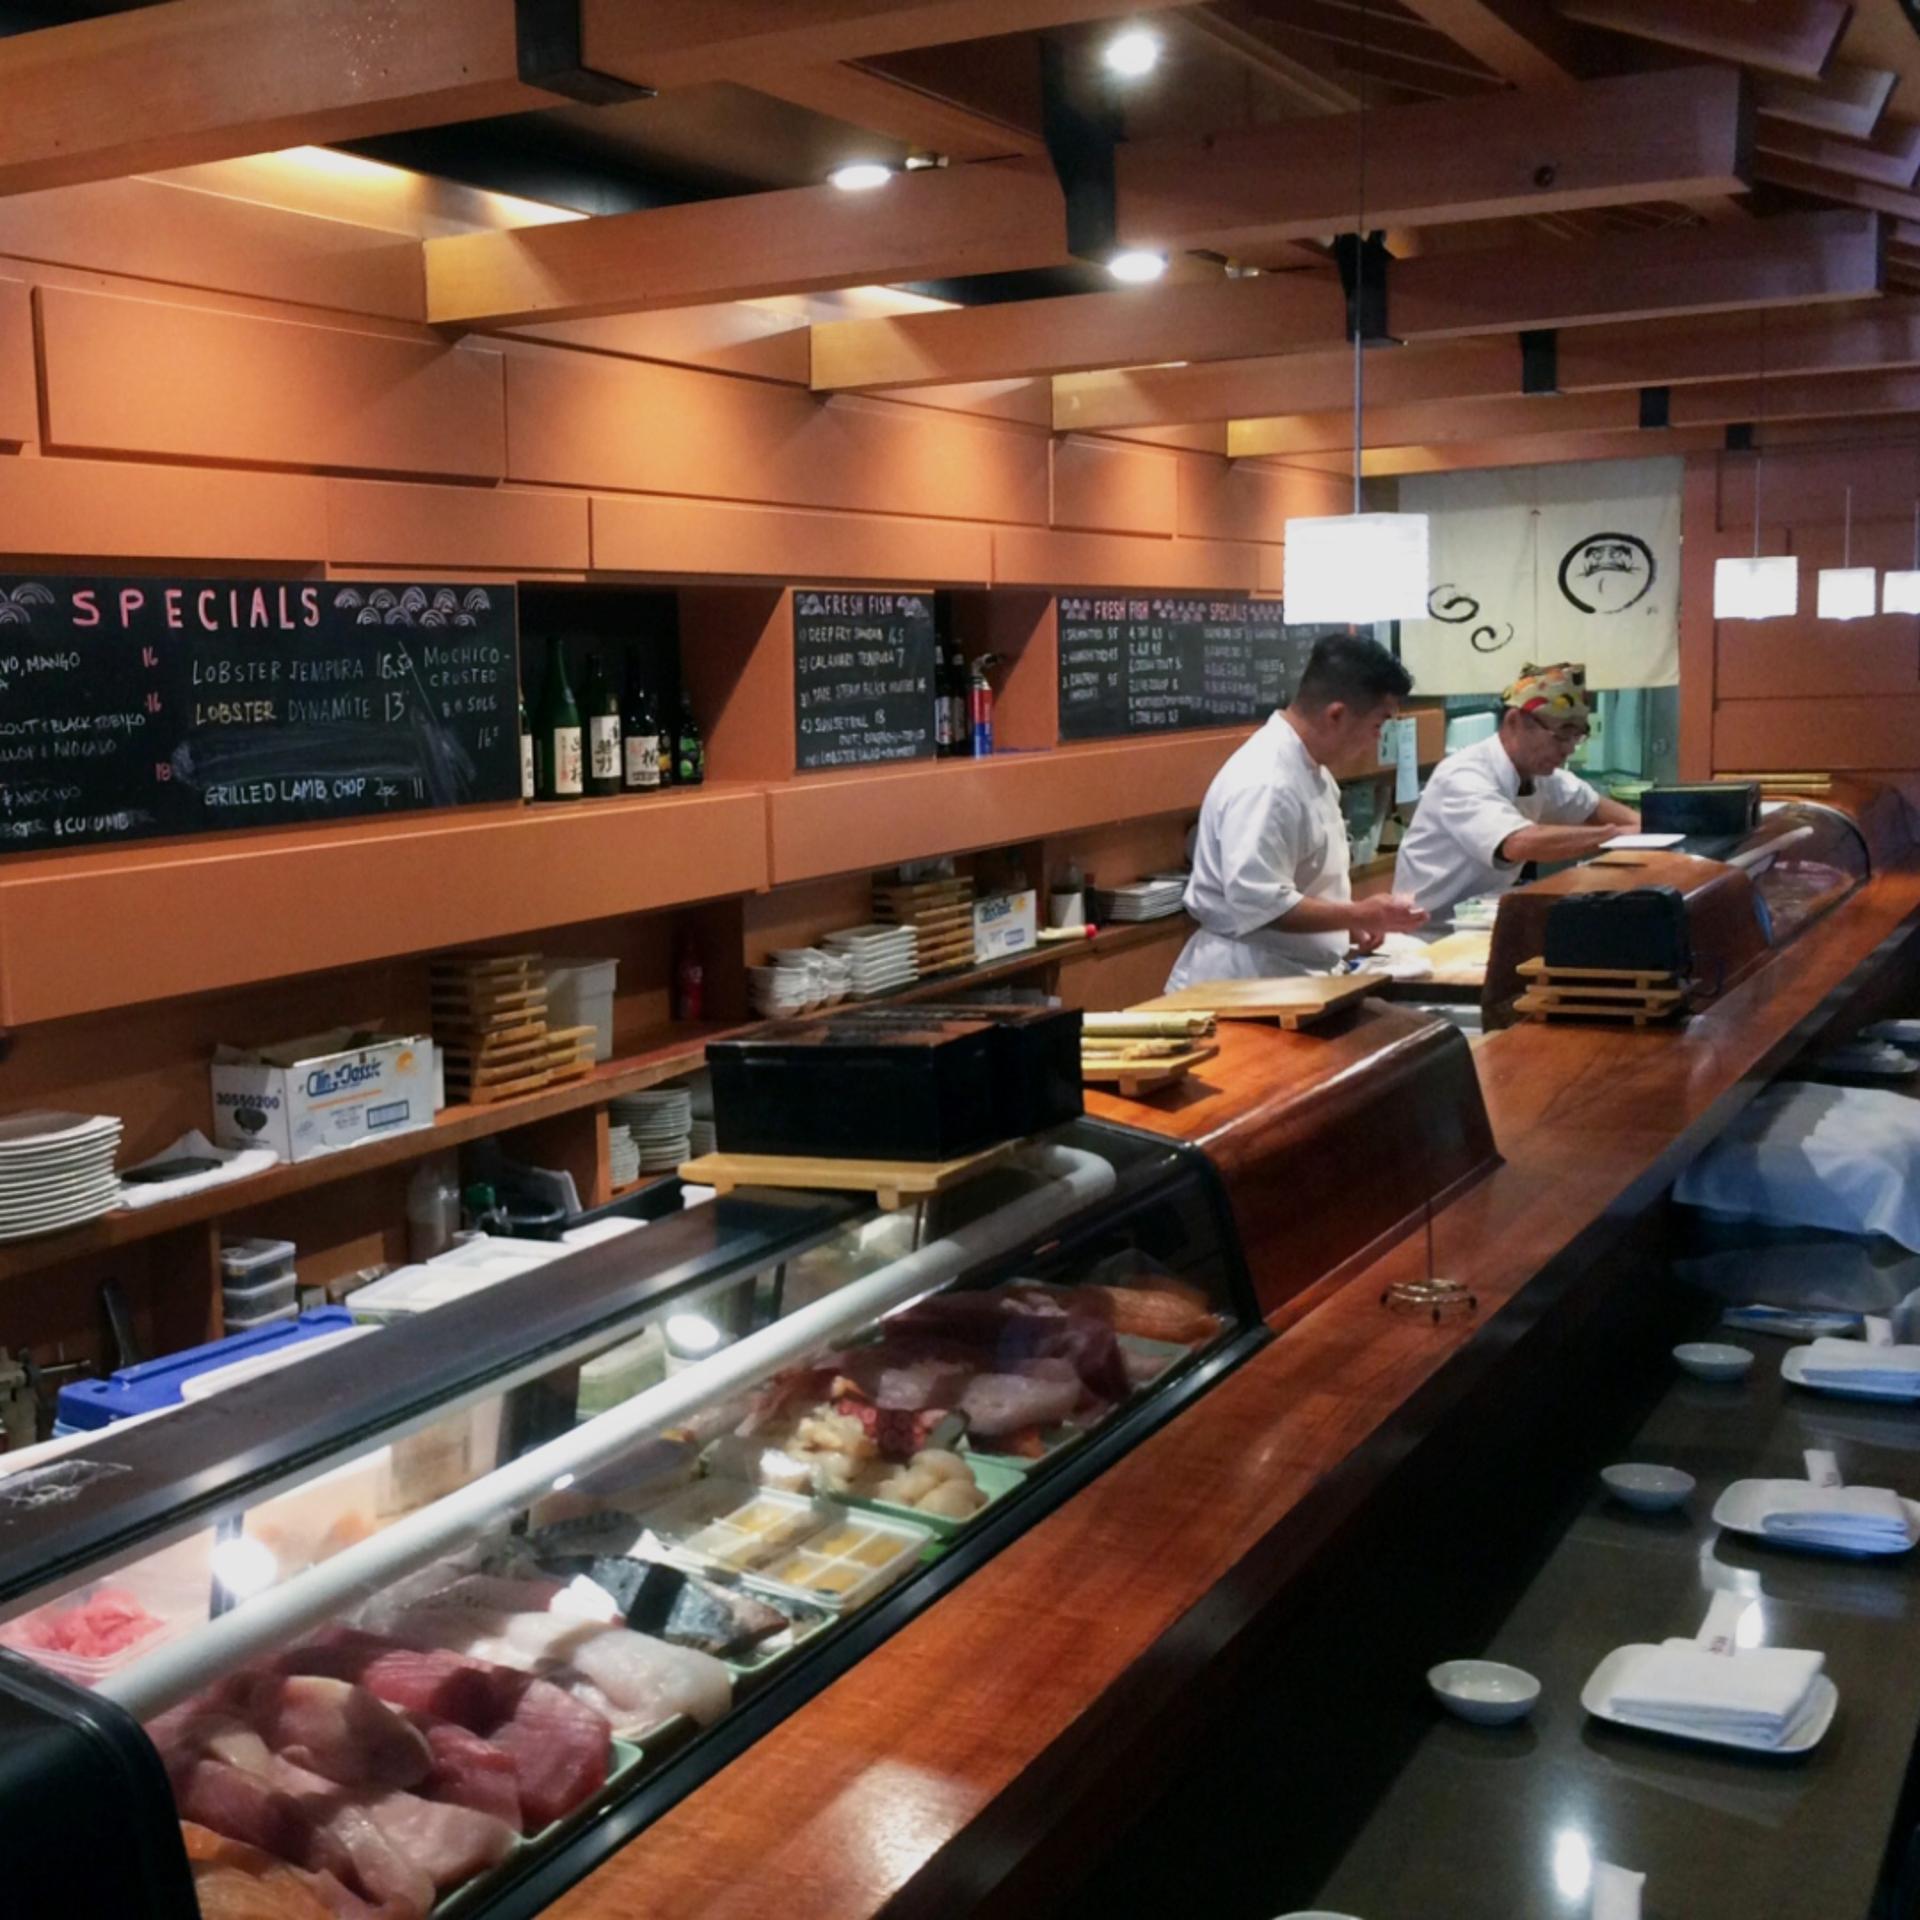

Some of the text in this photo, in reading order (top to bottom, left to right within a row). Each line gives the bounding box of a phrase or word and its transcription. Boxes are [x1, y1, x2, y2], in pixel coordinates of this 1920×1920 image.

[72, 585, 321, 631] SPECIALS
[824, 594, 894, 616] FRESH FISH
[1094, 600, 1126, 621] FRESH
[191, 659, 282, 686] LOBSTER
[430, 668, 498, 688] CRUSTED
[195, 700, 278, 726] LOBSTER
[288, 693, 370, 723] DYNAMITE
[204, 781, 277, 807] GRILLED
[280, 778, 328, 802] LAMB
[332, 777, 367, 800] CHOP
